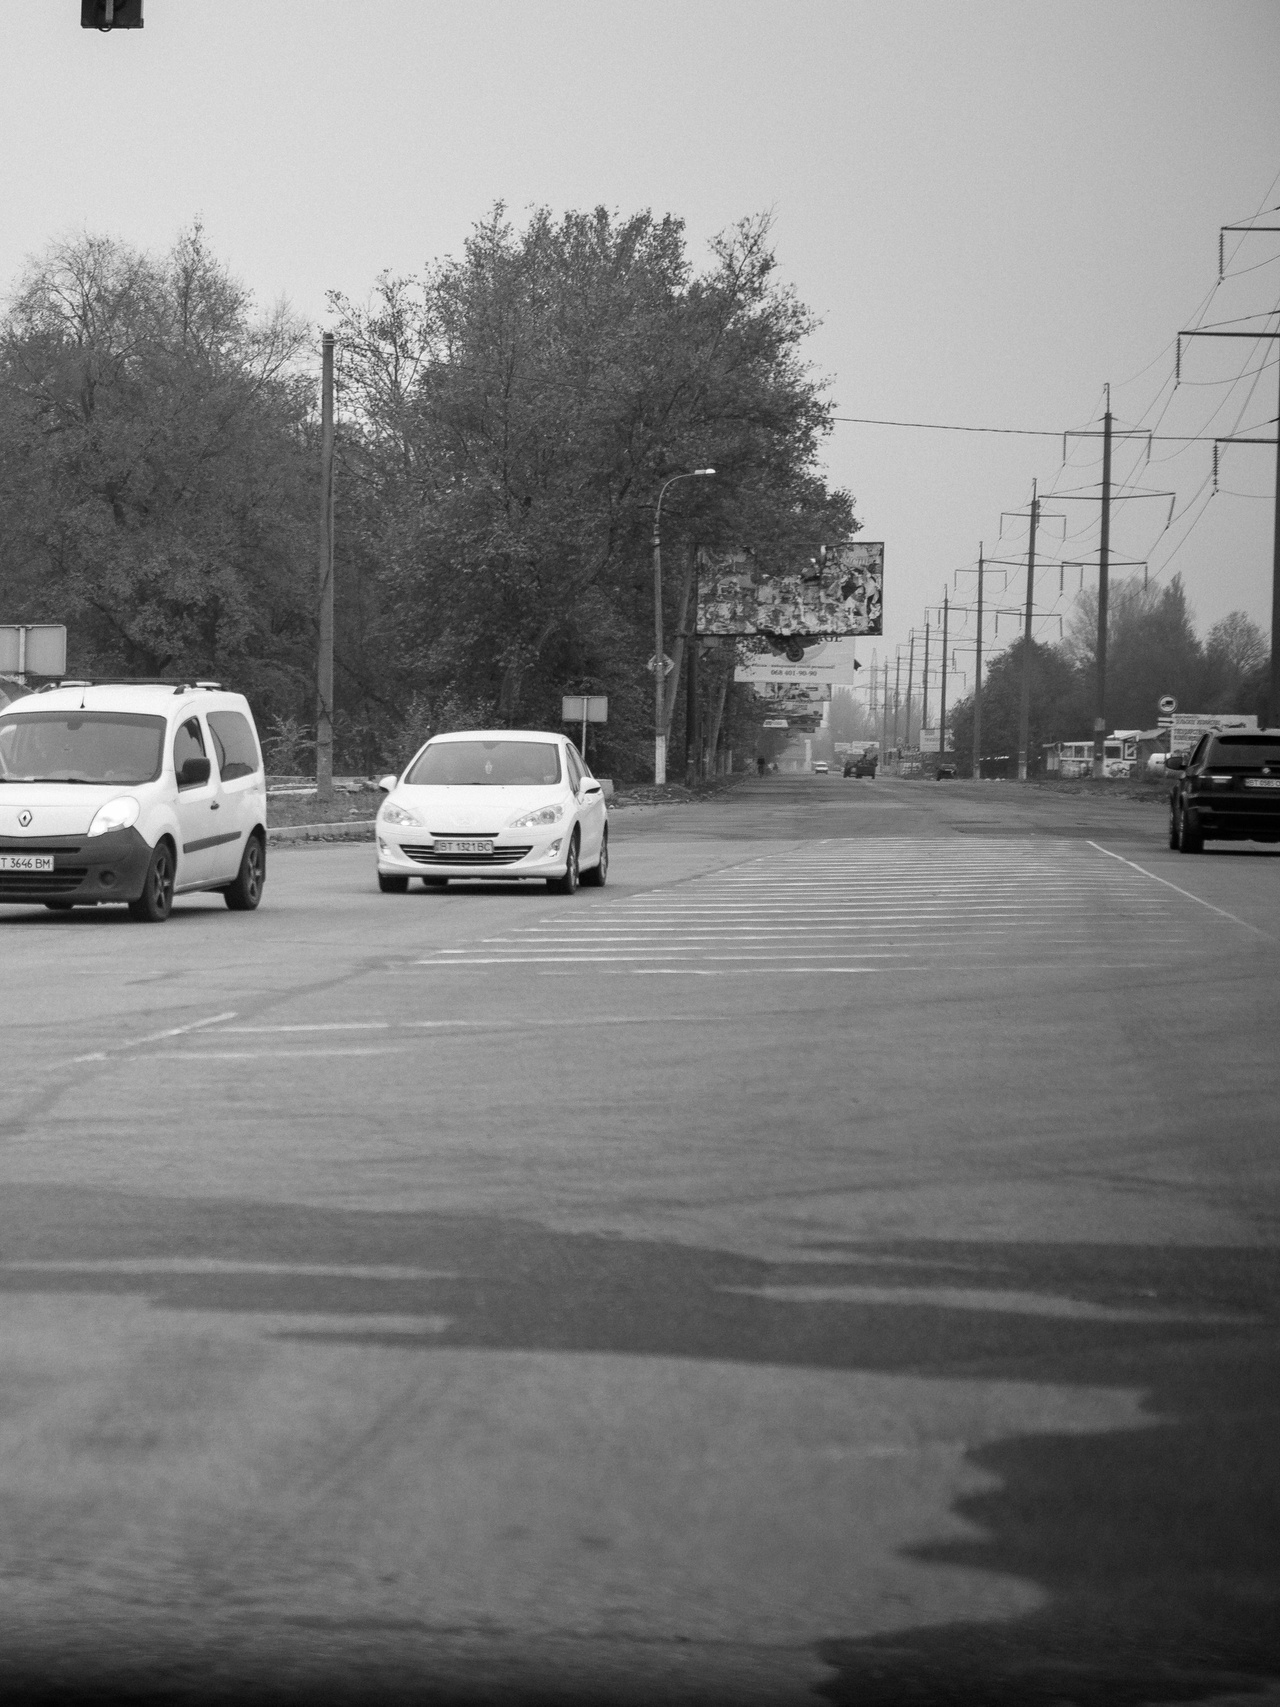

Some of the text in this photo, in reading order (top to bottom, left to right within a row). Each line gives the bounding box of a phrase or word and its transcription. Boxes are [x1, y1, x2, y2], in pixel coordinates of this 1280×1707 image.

[477, 842, 491, 852] BC
[10, 857, 33, 869] 3646
[35, 858, 51, 869] BM
